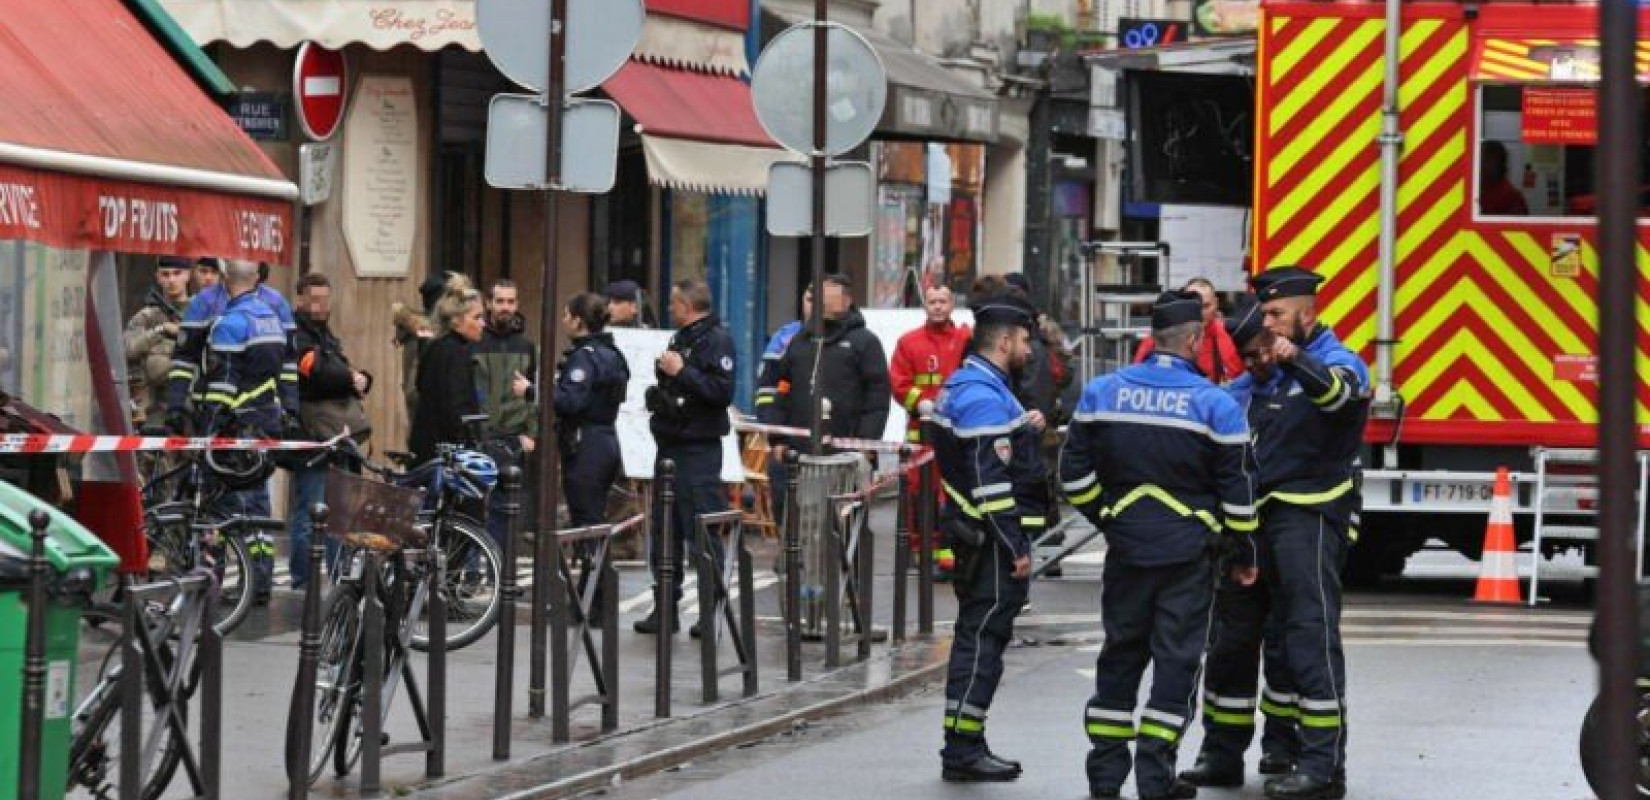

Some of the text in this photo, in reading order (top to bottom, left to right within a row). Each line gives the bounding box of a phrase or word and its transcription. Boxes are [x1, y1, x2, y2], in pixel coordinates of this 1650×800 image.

[368, 8, 425, 40] Chez
[241, 103, 273, 115] RUE
[99, 195, 127, 239] TOP
[131, 198, 179, 243] FRUITS
[1117, 387, 1192, 416] POLICE
